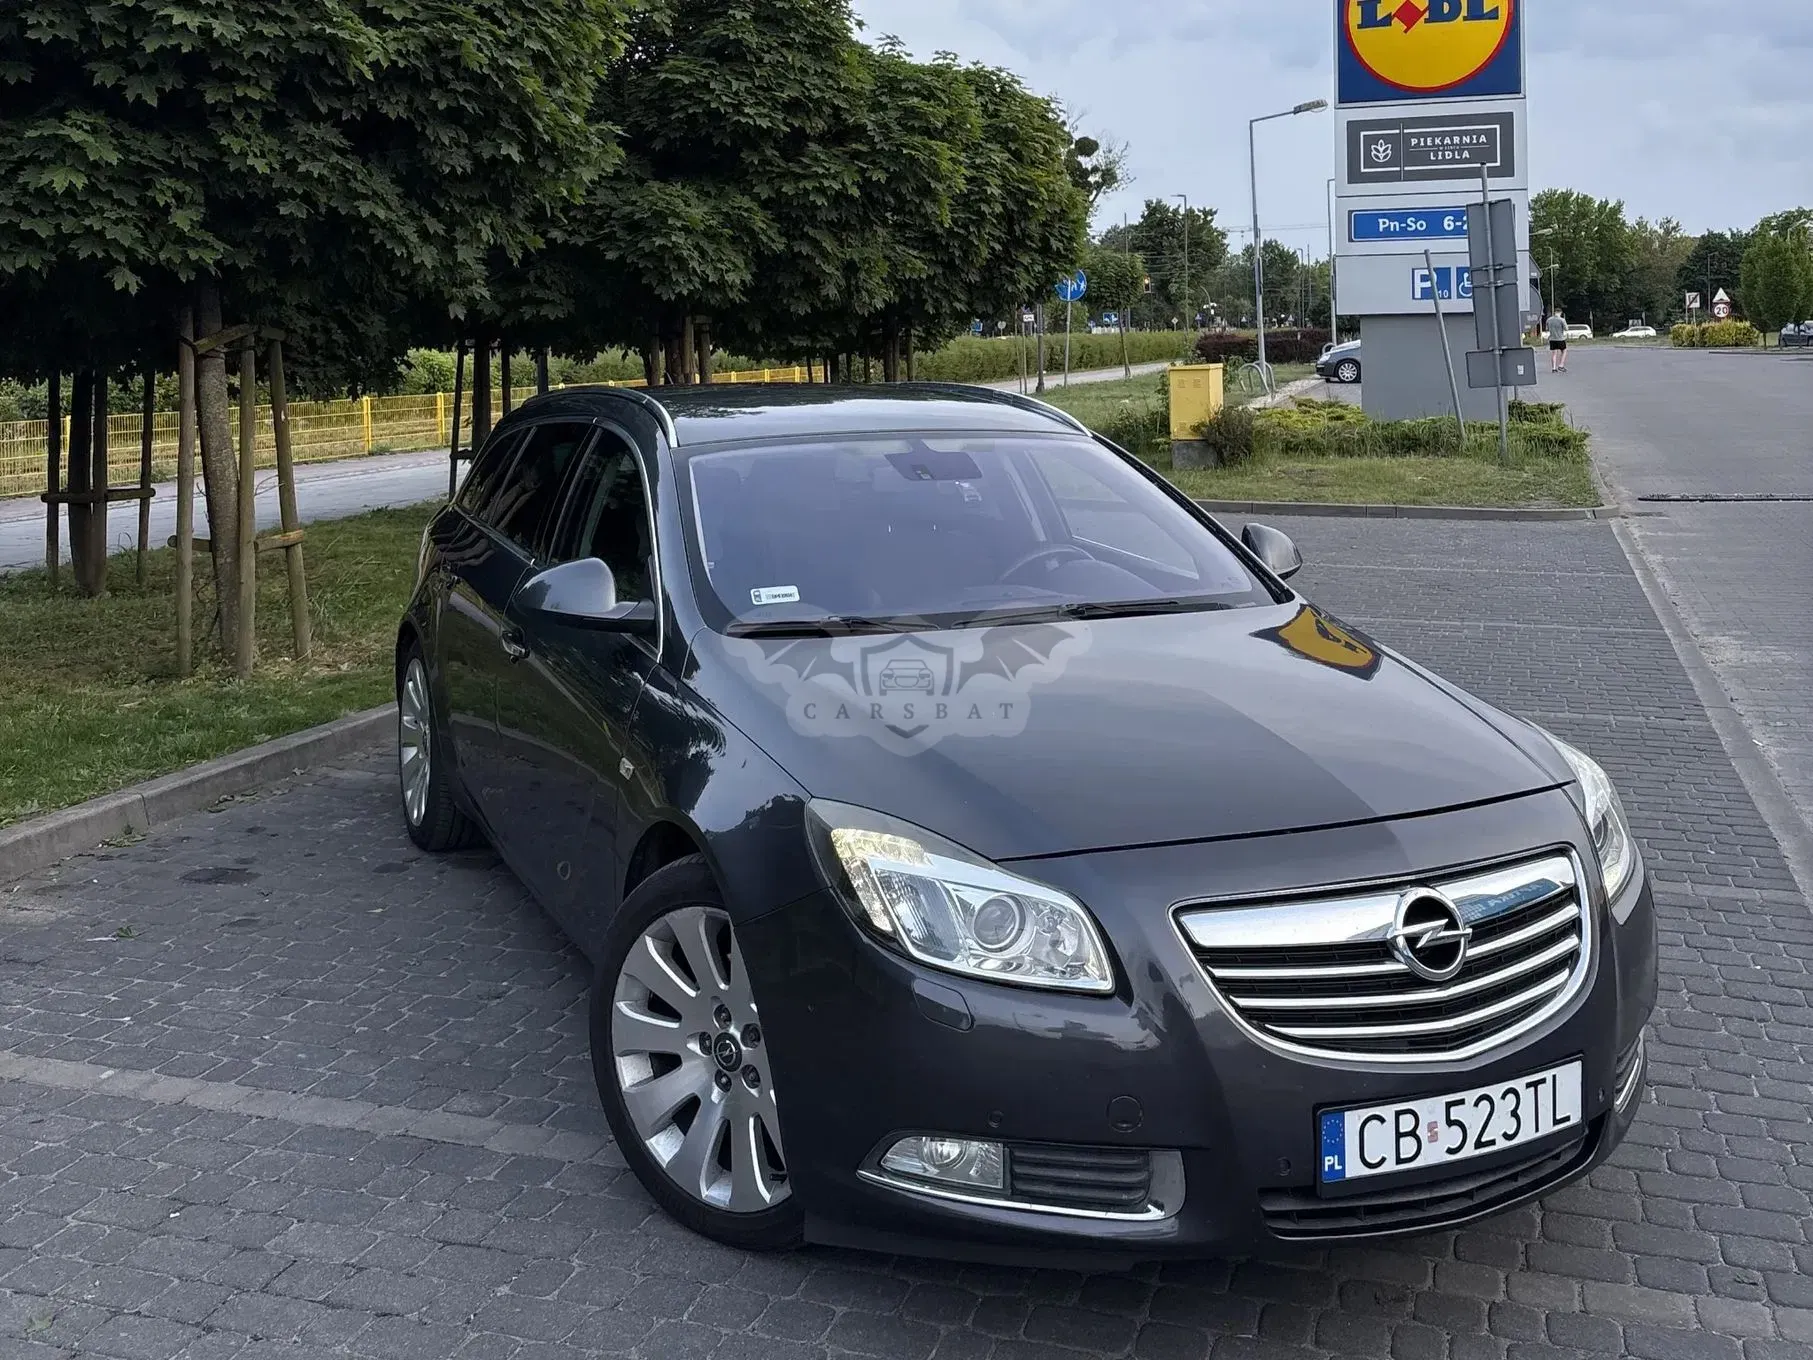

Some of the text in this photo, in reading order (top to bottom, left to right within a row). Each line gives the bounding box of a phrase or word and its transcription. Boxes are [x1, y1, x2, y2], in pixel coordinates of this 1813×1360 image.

[1410, 134, 1487, 146] PIEKARNIA
[1430, 150, 1470, 160] LIDLA
[1378, 217, 1427, 232] Pn-So
[1715, 306, 1728, 315] 20
[1324, 1074, 1572, 1172] PL CB 523TL
